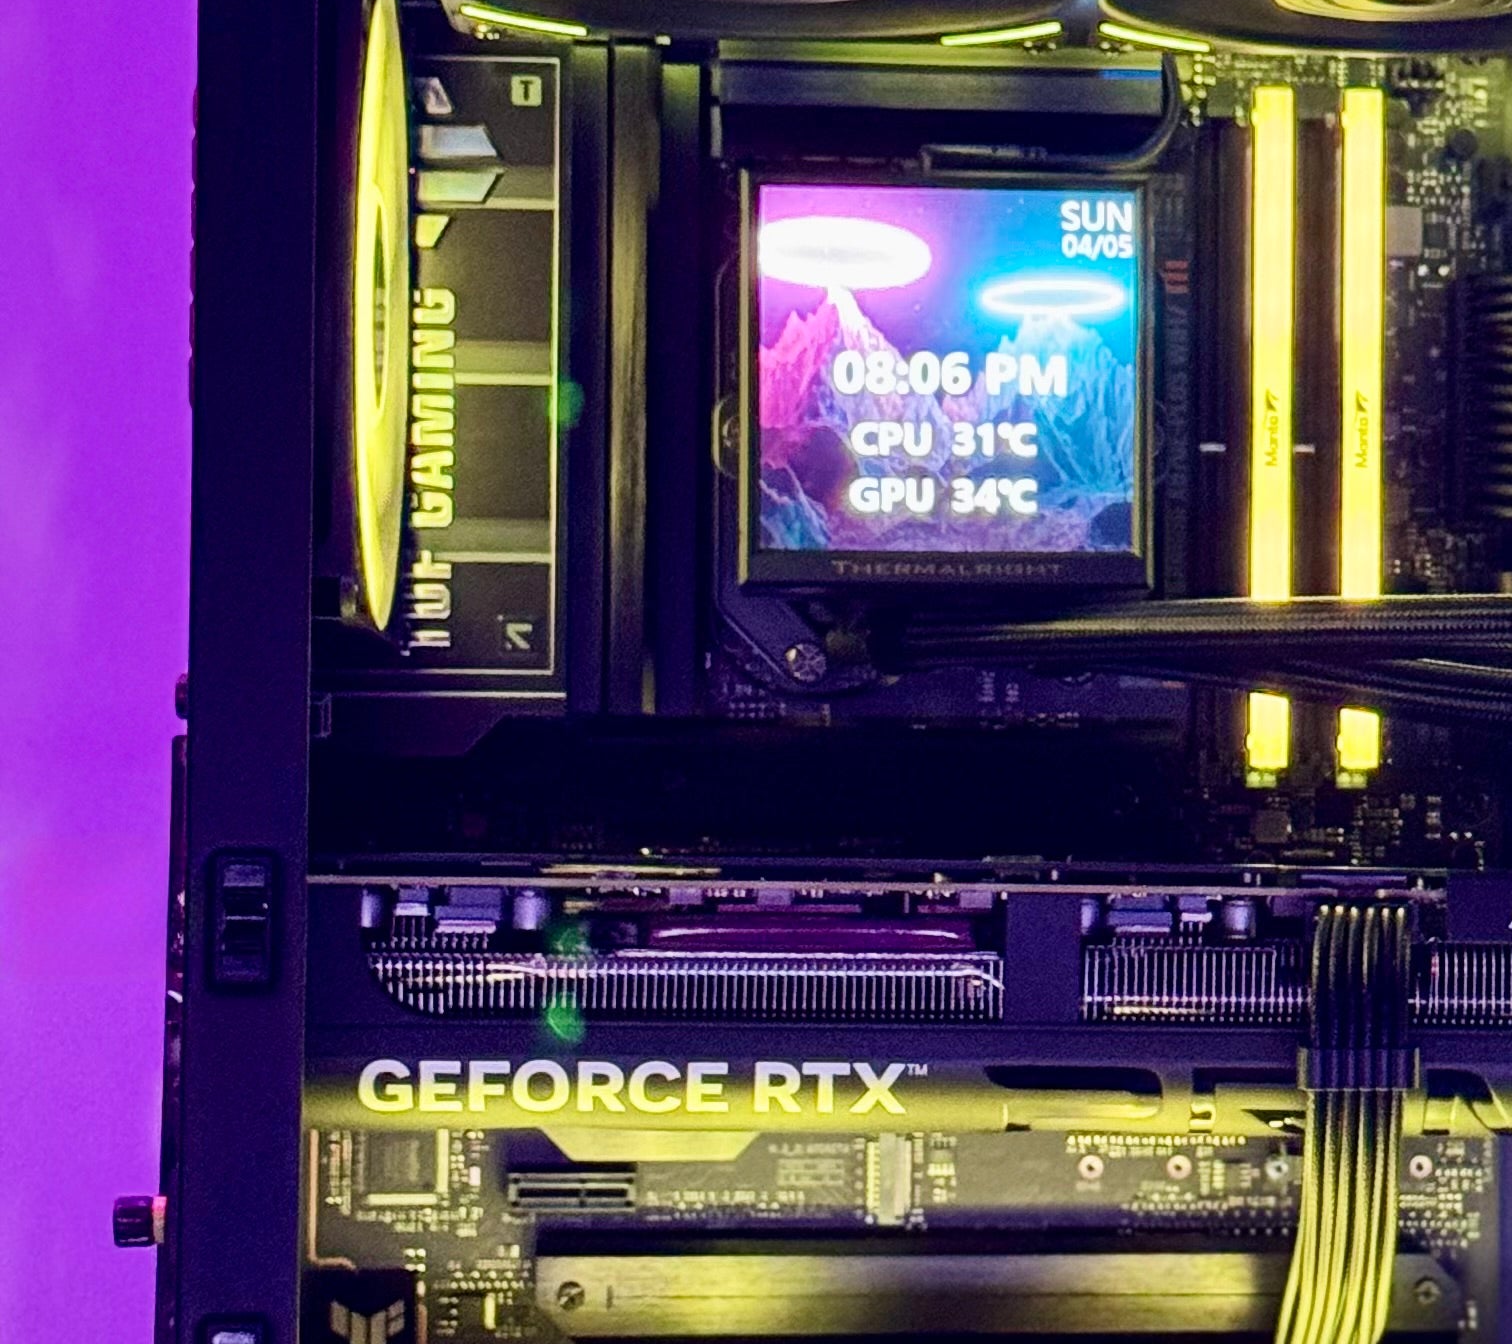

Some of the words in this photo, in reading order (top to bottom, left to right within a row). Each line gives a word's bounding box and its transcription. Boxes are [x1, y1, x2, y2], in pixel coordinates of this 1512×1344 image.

[1060, 200, 1133, 233] SUN
[1060, 233, 1133, 259] 04/05
[832, 350, 971, 397] 08:06
[984, 351, 1069, 398] PM
[411, 286, 454, 529] GAMING
[850, 421, 933, 458] CPU
[950, 421, 1038, 458] 31°C
[848, 476, 936, 515] GPU
[949, 476, 1038, 515] 34°C
[831, 559, 1062, 576] THERMALRIGHT
[357, 1058, 729, 1114] GEFORCE
